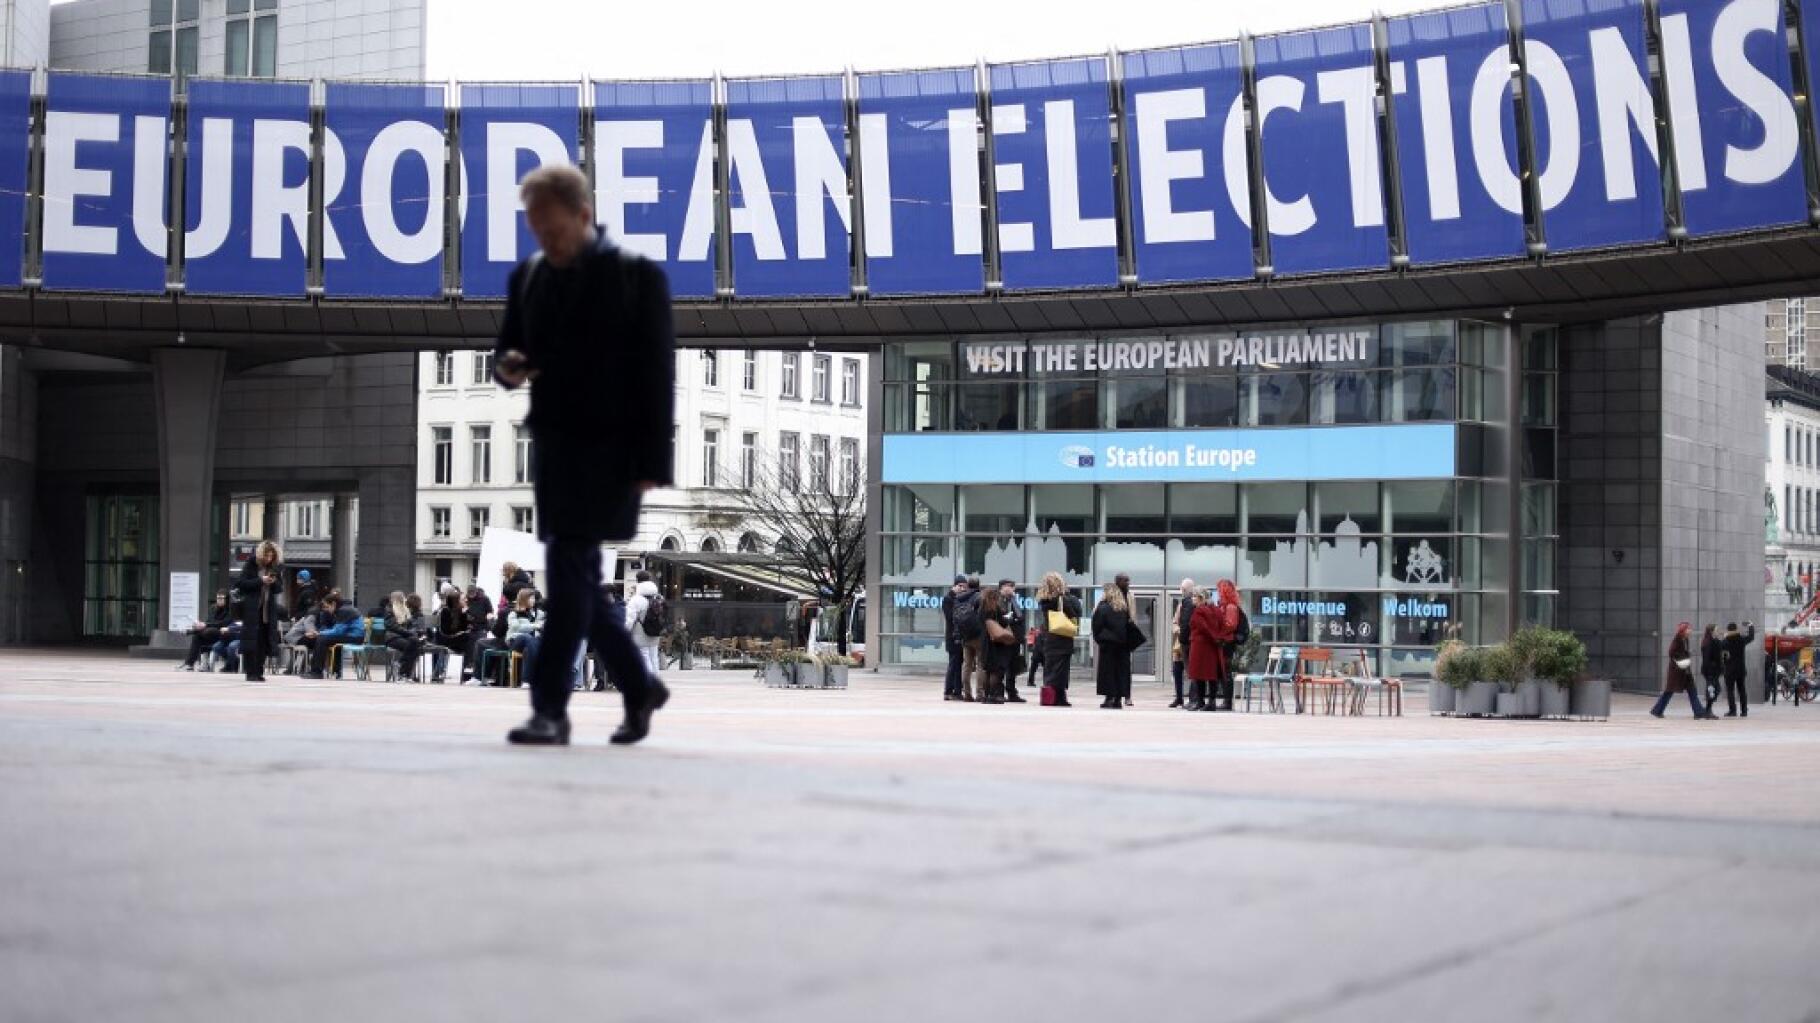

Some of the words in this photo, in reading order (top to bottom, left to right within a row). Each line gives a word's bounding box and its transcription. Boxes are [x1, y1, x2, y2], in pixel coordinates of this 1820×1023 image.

[42, 111, 893, 263] EUROPEAN
[948, 0, 1799, 254] ELECTIONS
[966, 345, 1027, 373] VISIT
[1032, 344, 1078, 372] THE
[1083, 340, 1210, 371] EUROPEAN
[1216, 331, 1371, 367] PARLIAMENT
[1106, 445, 1180, 468] Station
[1185, 444, 1257, 472] Europe
[1261, 596, 1347, 616] Bienvenue
[1383, 598, 1448, 618] Welkom
